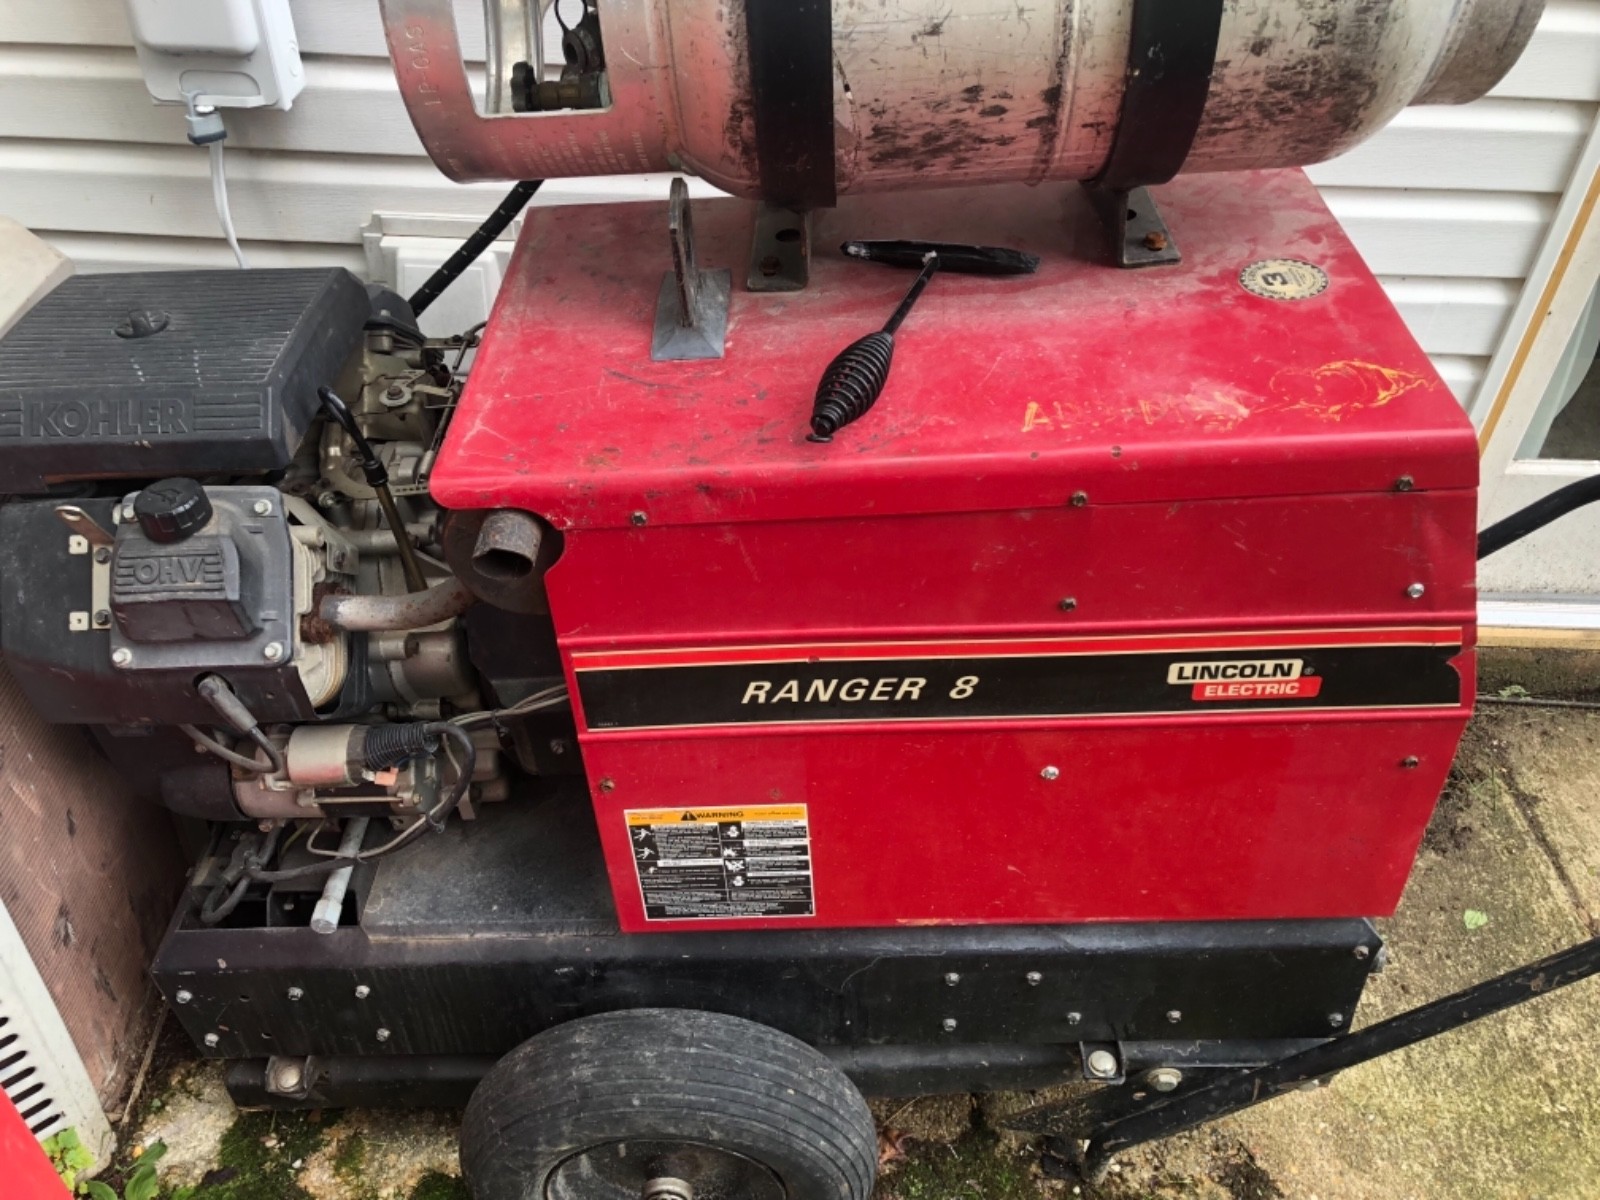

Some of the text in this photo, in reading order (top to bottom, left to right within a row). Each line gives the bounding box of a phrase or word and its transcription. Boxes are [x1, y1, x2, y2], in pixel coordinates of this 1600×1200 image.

[1261, 272, 1288, 286] 3
[31, 398, 189, 438] KOHLER
[133, 557, 205, 585] OHV
[1177, 662, 1295, 681] LINCOLN
[741, 675, 980, 704] RANGER 8
[1204, 682, 1300, 698] ELECTRIC
[696, 810, 744, 819] WARNING
